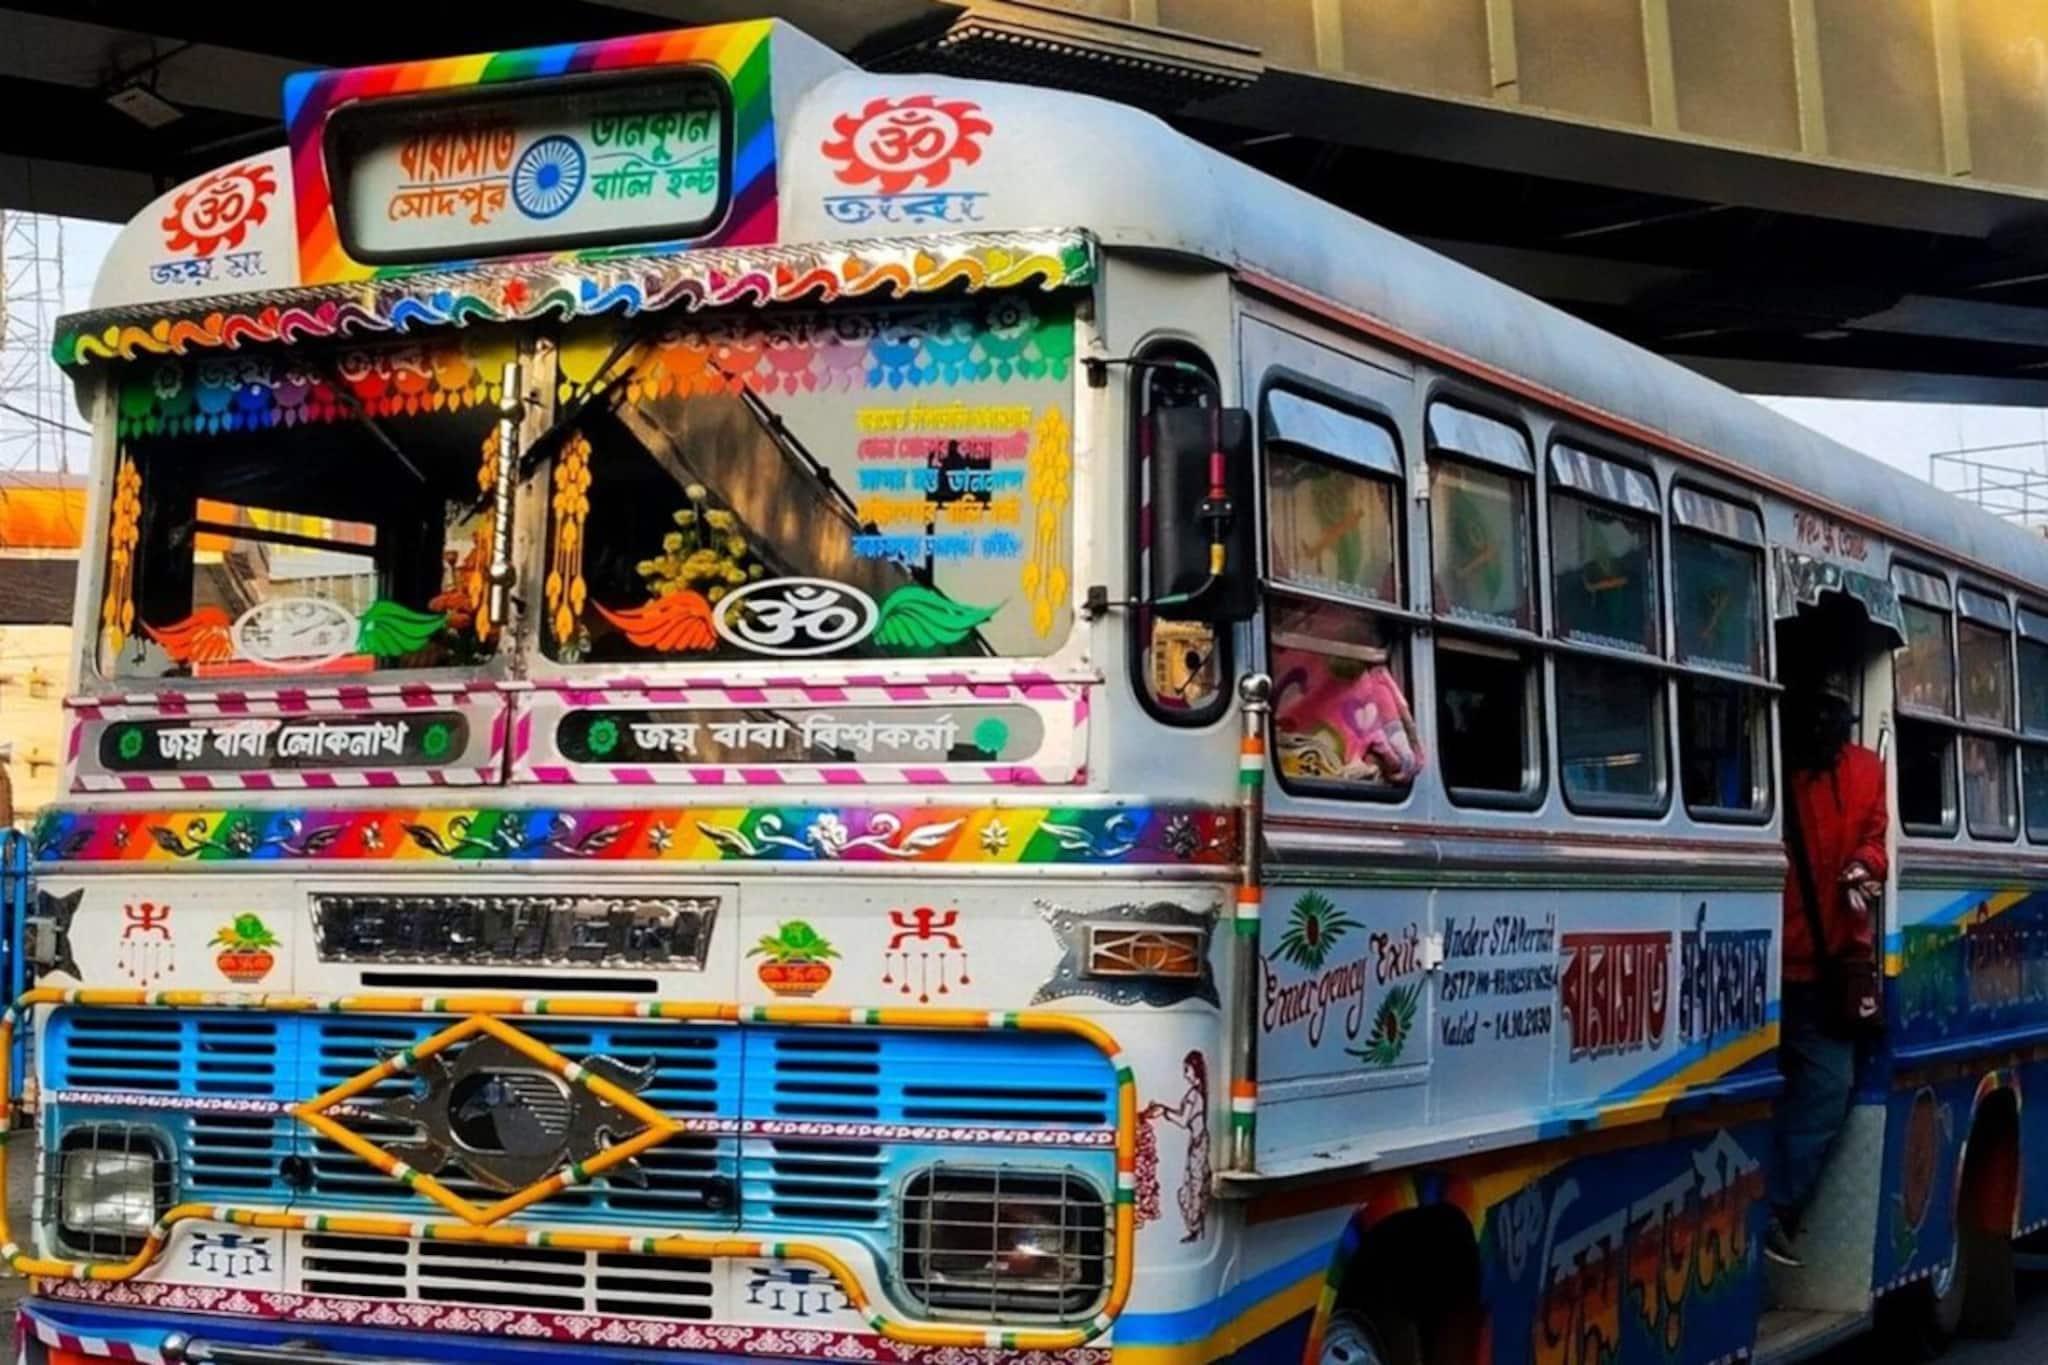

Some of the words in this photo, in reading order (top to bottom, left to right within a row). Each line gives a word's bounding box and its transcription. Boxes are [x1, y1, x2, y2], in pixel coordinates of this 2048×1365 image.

[590, 159, 658, 201] বালি
[388, 182, 509, 225] সোদপুর
[157, 726, 205, 761] জয়
[213, 723, 273, 758] বাবা
[277, 720, 410, 759] লোকনাথ
[631, 720, 699, 752] জয়
[709, 720, 793, 750] বাবা
[796, 711, 962, 754] বিশ্বকর্মা
[1259, 954, 1368, 1048] Emergency
